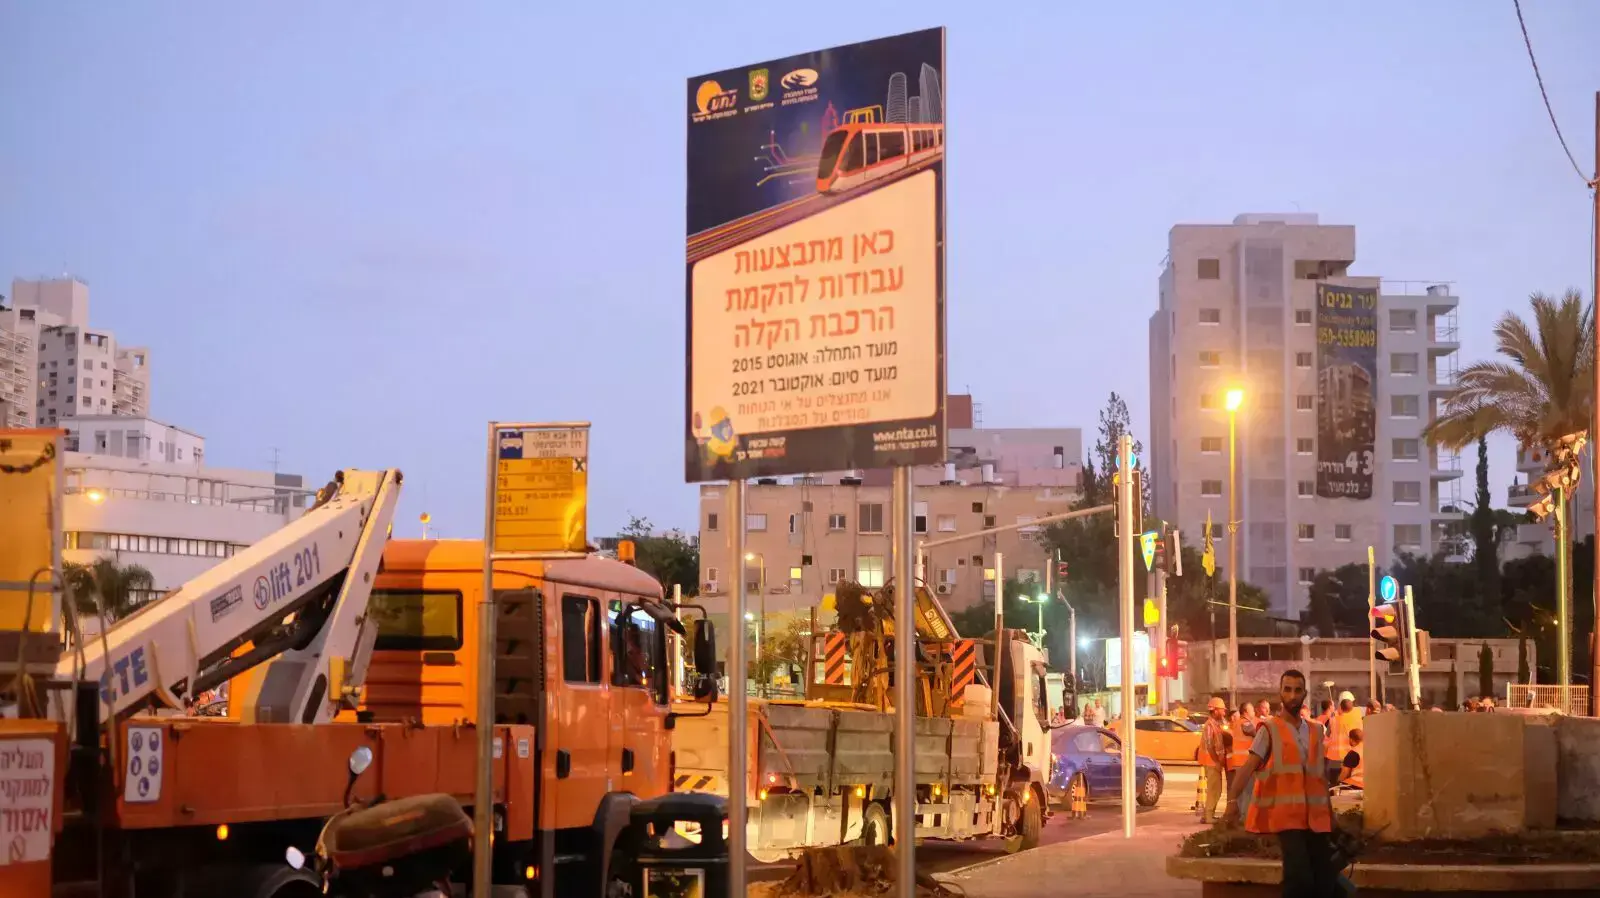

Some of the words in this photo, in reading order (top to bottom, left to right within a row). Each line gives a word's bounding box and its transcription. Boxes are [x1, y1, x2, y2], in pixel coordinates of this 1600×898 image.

[734, 236, 843, 275] מתבצעות
[852, 229, 894, 264] כאן
[818, 265, 904, 300] עבודות
[725, 275, 810, 314] להקמת
[809, 306, 894, 339] הרכבת
[734, 317, 800, 350] הקלה
[812, 345, 861, 364] התחלה:
[865, 341, 898, 357] מועד
[732, 356, 763, 373] 2015
[767, 351, 808, 369] אוגוסט
[828, 369, 860, 386] סיום:
[864, 365, 898, 381] מועד
[732, 380, 765, 396] 2021
[768, 373, 824, 392] אוקטובר
[796, 394, 812, 408] על
[816, 390, 868, 407] מתנצלים
[872, 388, 892, 401] אנו
[738, 401, 776, 415] הנוחות
[781, 400, 792, 410] אי
[758, 413, 808, 429] הסבלנות
[812, 411, 828, 426] על
[873, 425, 937, 443] www.nta.co.il
[270, 562, 292, 602] lift
[294, 541, 320, 586] 201
[100, 646, 148, 705] CTE
[0, 745, 44, 770] העליה
[2, 808, 48, 832] אסור
